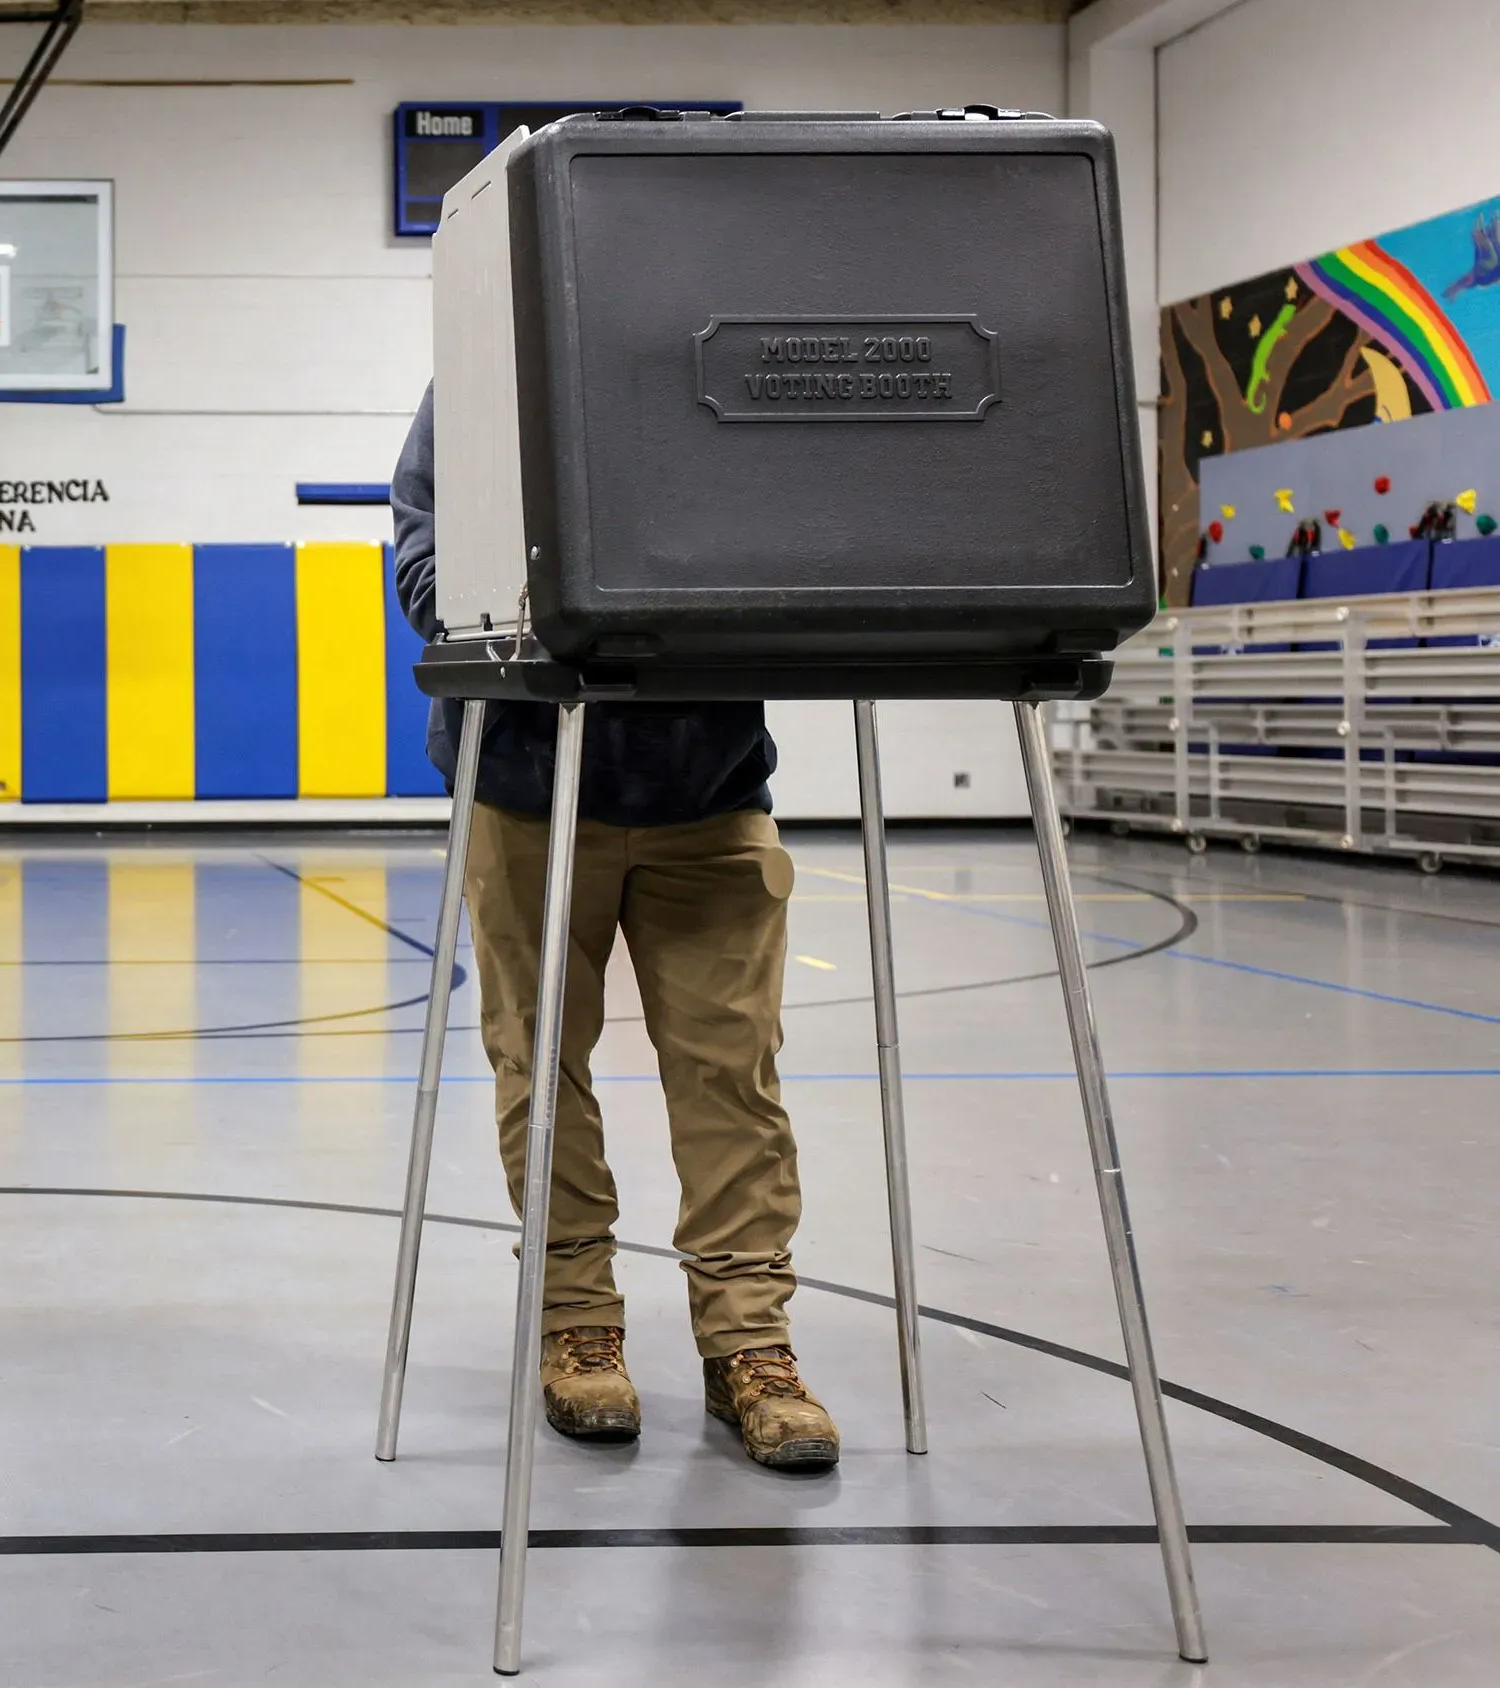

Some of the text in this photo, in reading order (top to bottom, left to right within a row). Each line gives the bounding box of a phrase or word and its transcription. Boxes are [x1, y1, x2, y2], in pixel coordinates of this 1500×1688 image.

[416, 111, 473, 135] Home
[760, 337, 933, 363] MODEL 2000
[744, 373, 952, 399] VOTING BOOTH
